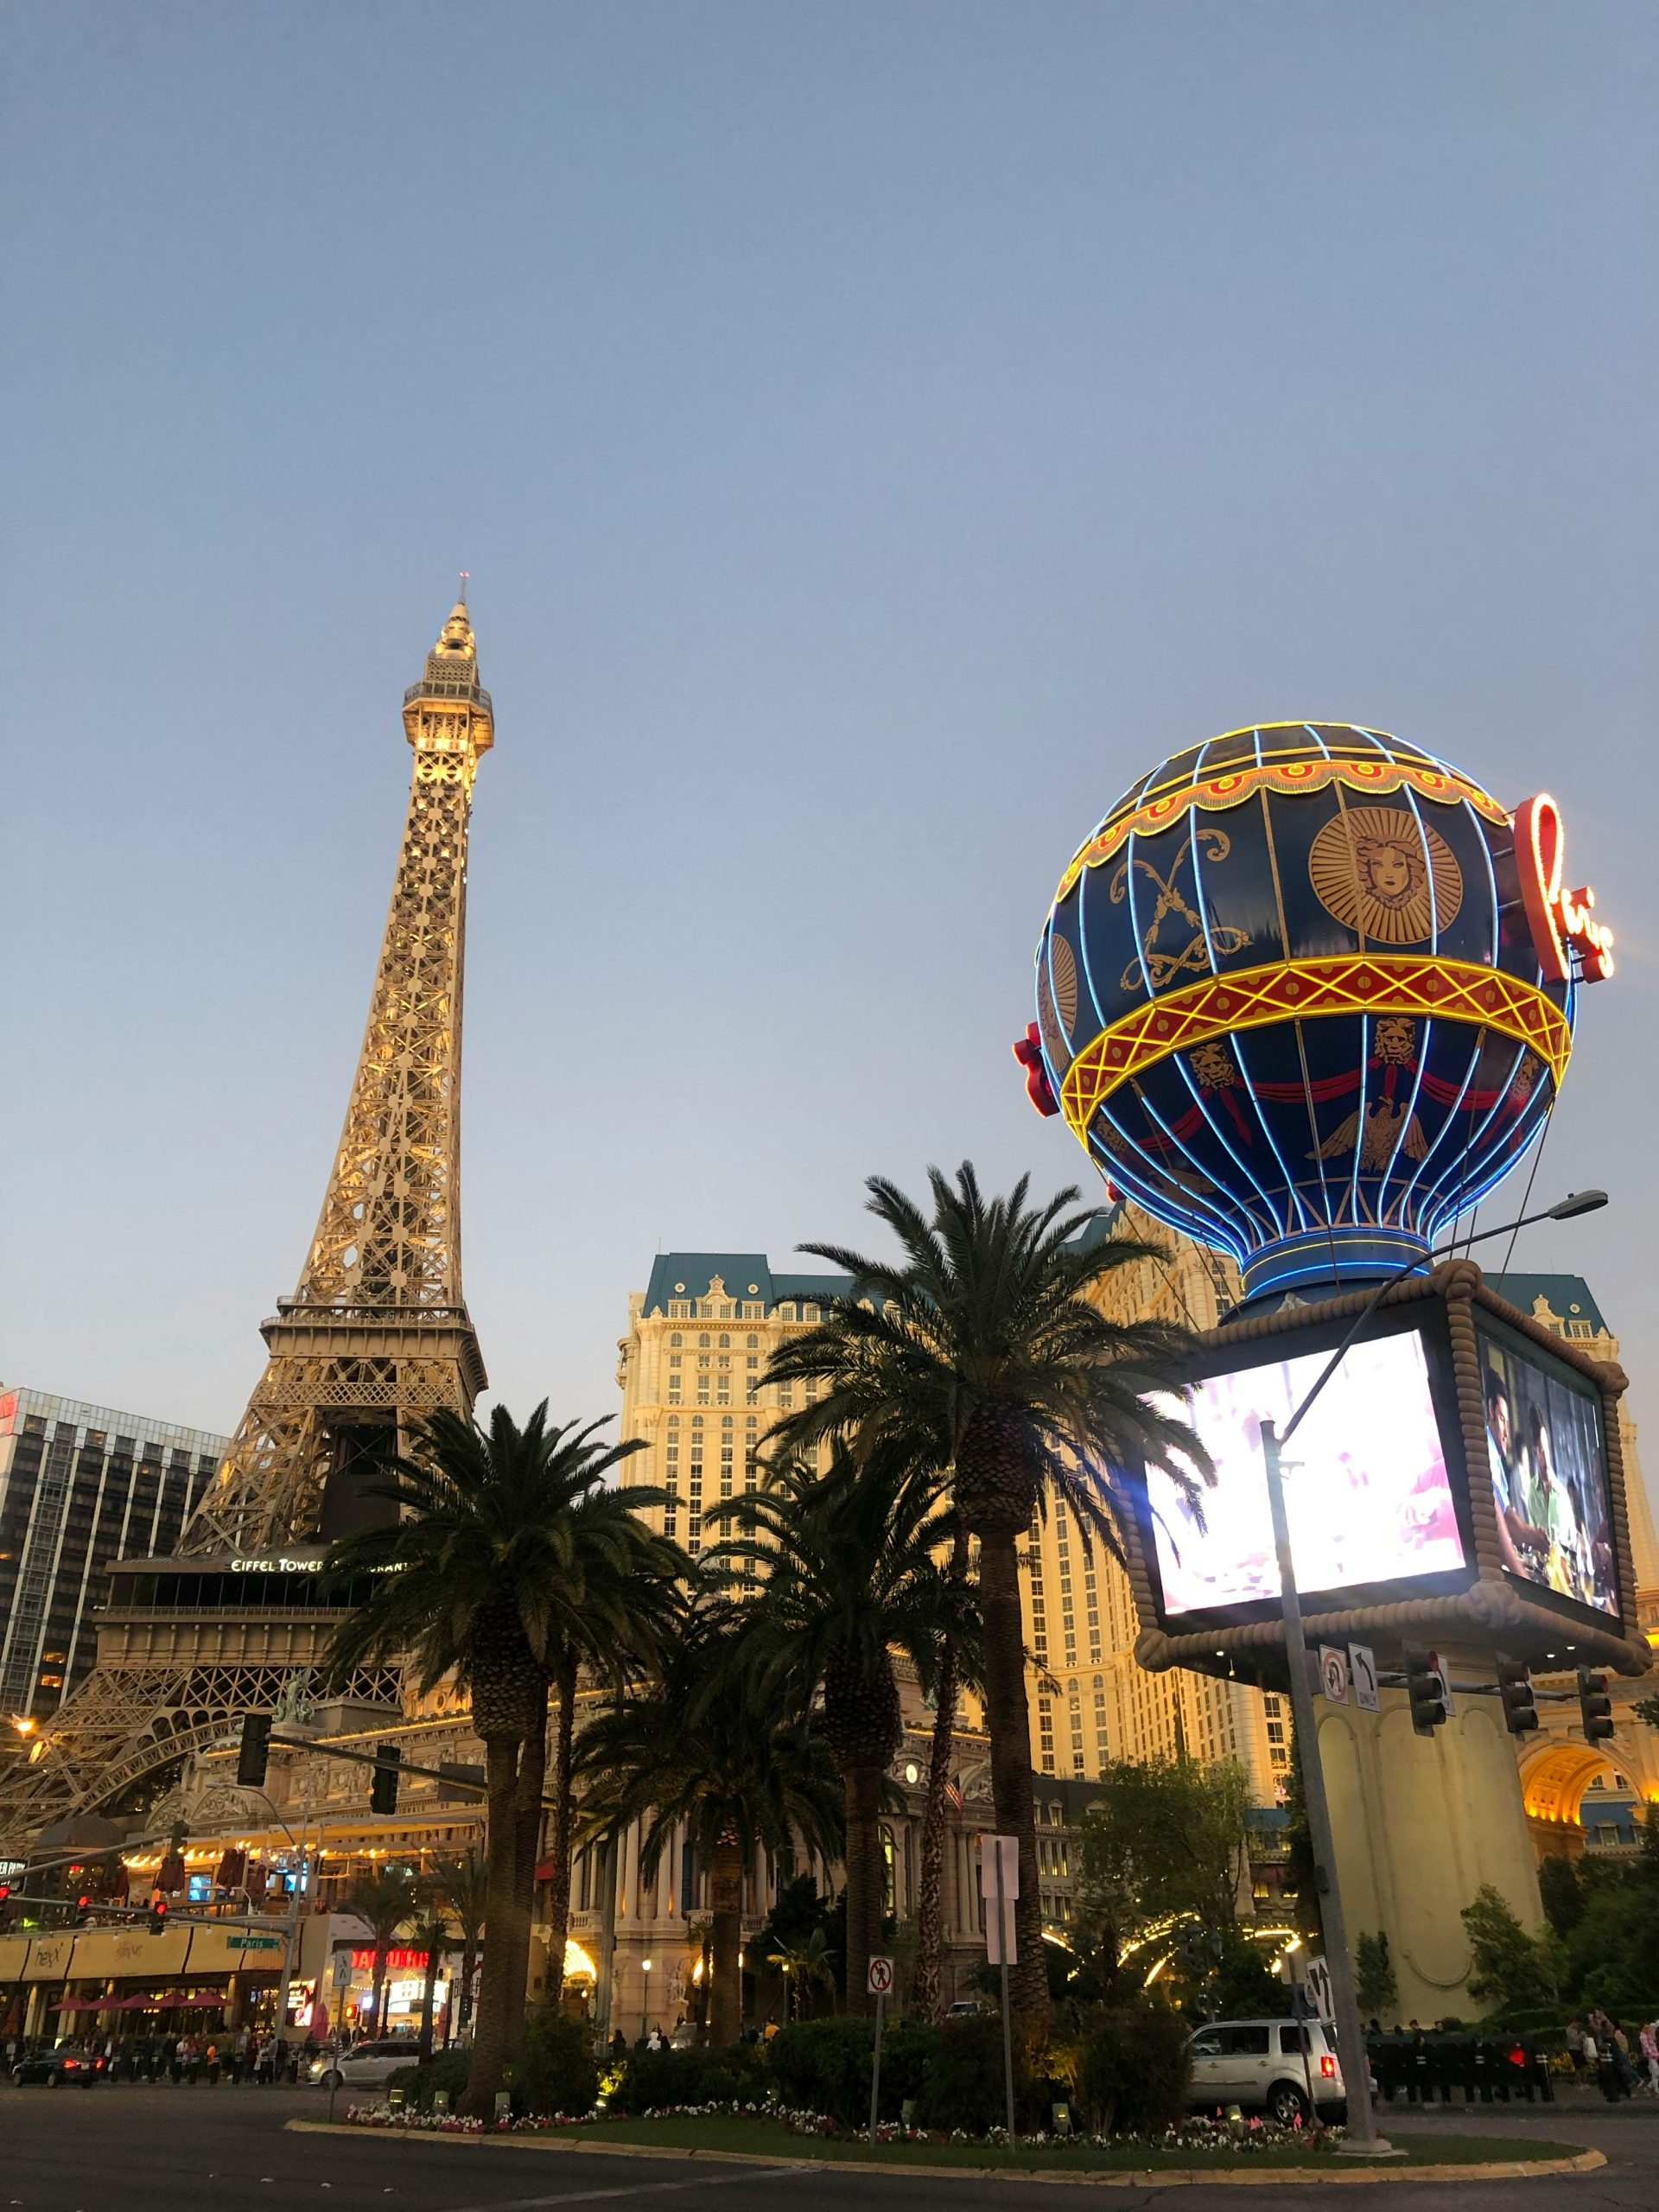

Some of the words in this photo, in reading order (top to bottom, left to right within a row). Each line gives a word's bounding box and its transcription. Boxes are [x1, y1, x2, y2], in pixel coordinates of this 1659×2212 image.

[231, 1560, 275, 1572] EIFFEL
[1359, 1692, 1376, 1707] ONLY
[240, 1938, 264, 1948] Paris
